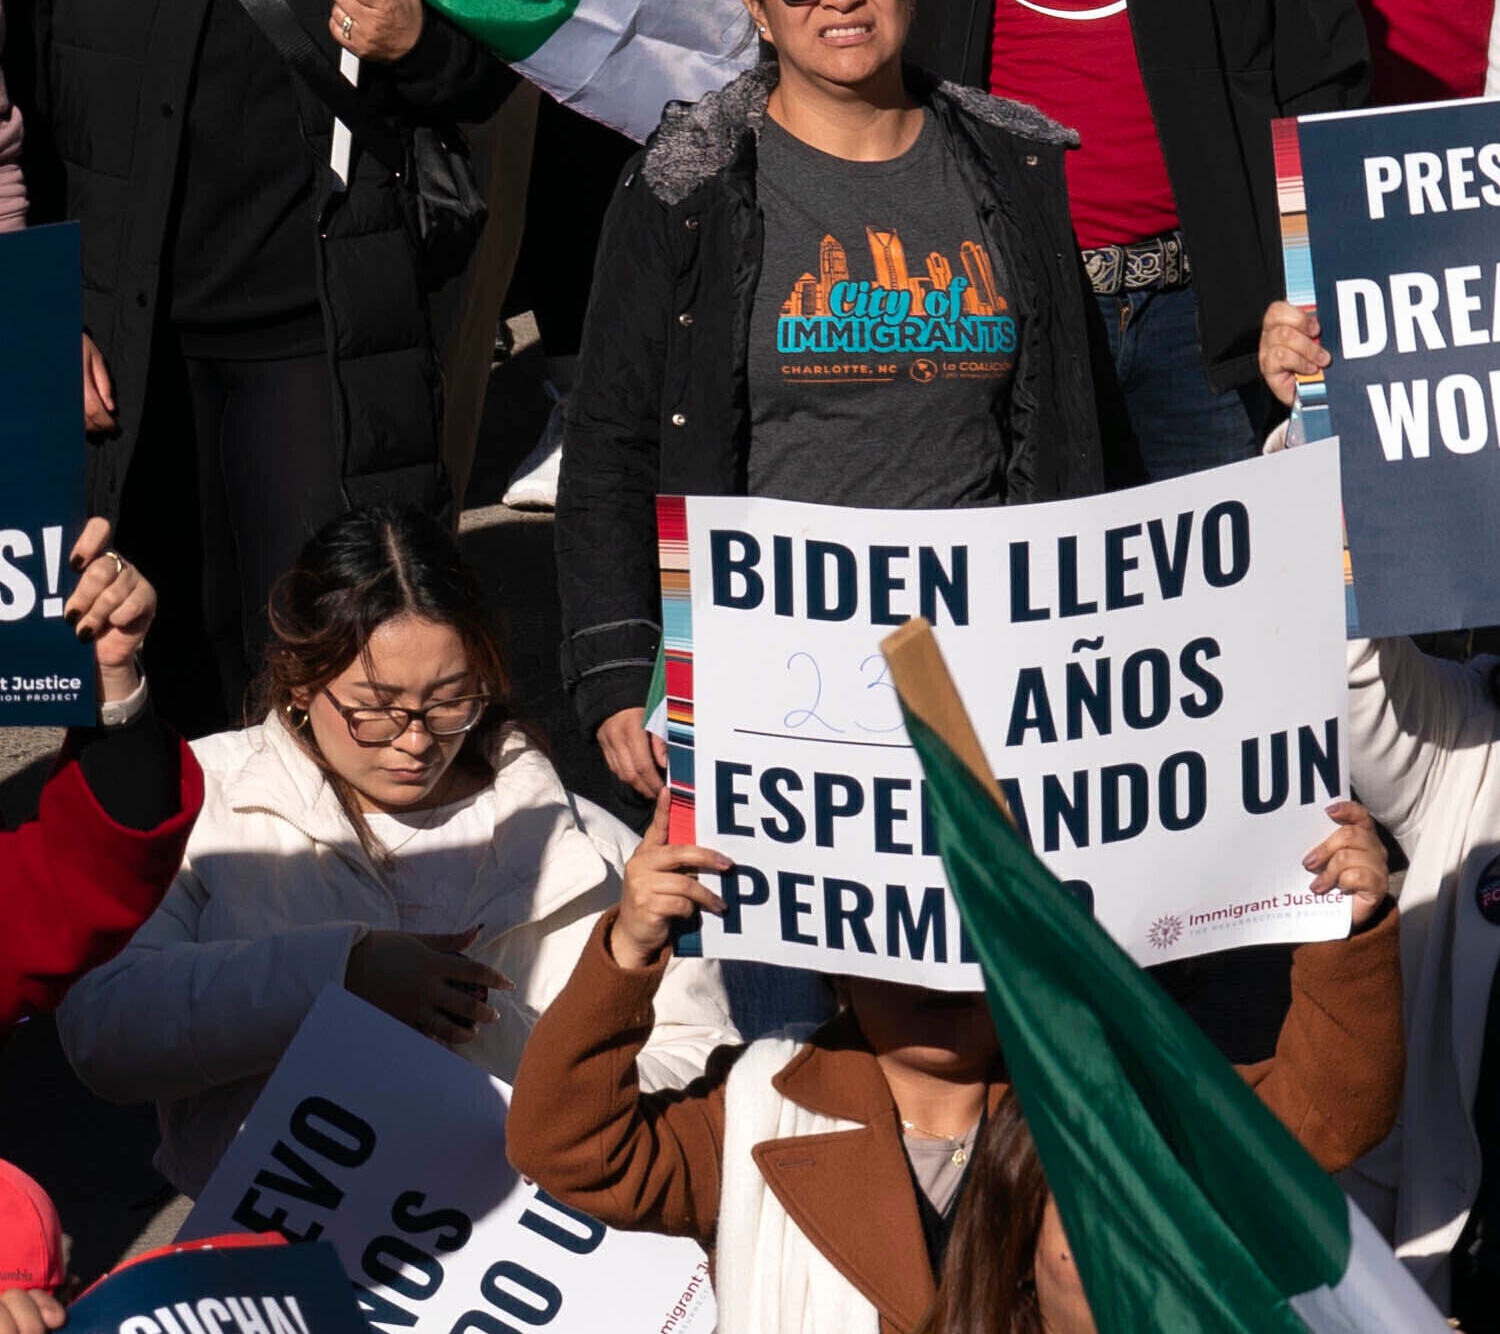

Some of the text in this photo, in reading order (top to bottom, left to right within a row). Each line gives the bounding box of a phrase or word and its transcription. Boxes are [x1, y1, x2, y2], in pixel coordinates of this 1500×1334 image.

[829, 276, 969, 325] City of
[778, 316, 1016, 354] IMMIGRANTS
[781, 364, 897, 375] CHARLOTTE, NC
[710, 499, 1254, 628] BIDEN LLEVO
[11, 674, 82, 692] Justice
[26, 693, 80, 702] PROJECT
[1008, 635, 1225, 751] AÑOS
[1239, 716, 1343, 808] UN
[1188, 896, 1279, 928] Immigrant
[1282, 890, 1345, 907] Justice
